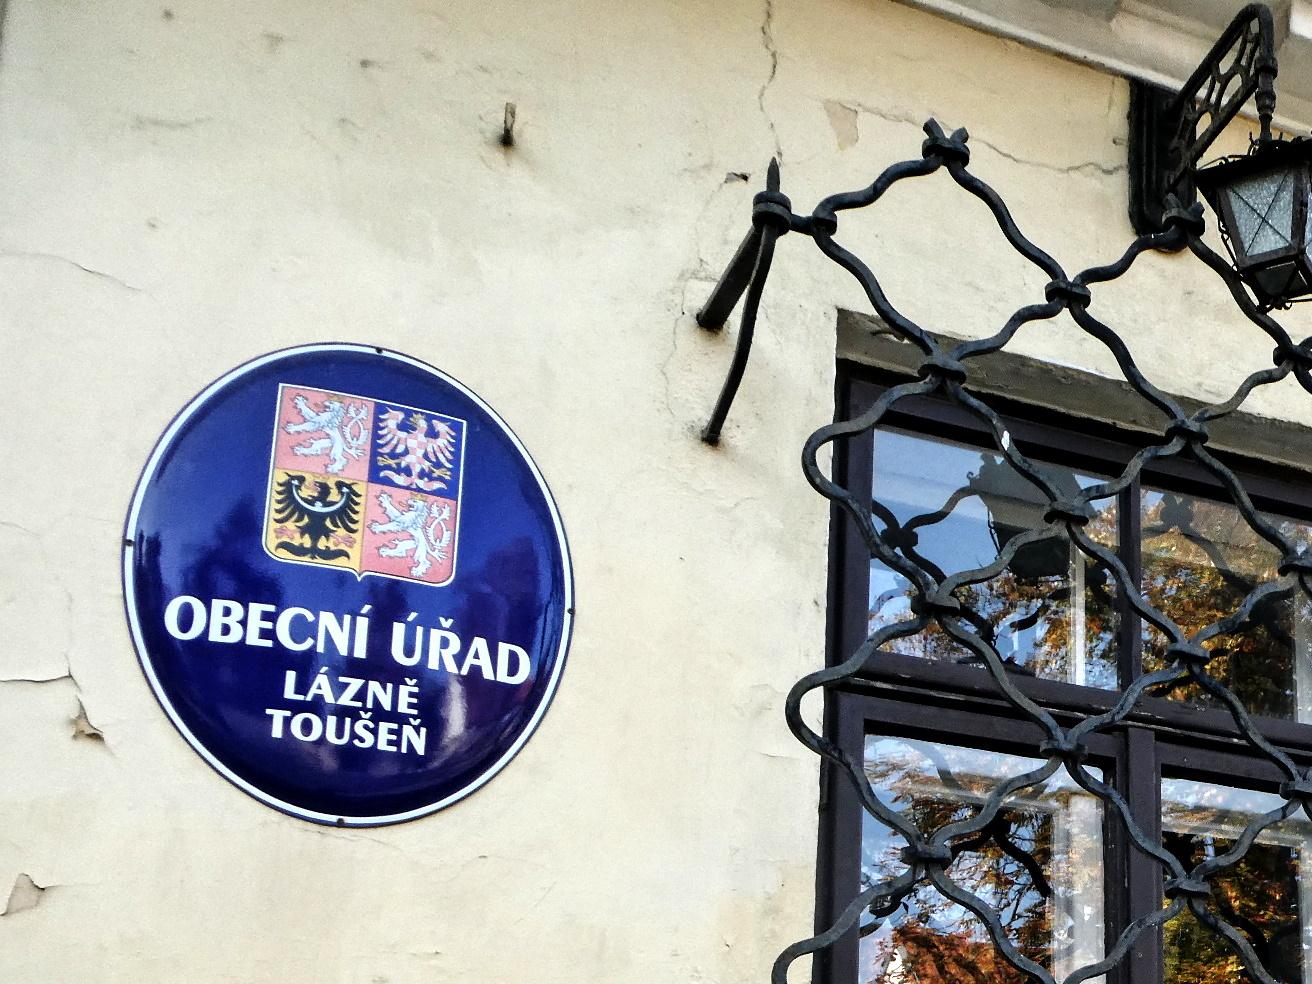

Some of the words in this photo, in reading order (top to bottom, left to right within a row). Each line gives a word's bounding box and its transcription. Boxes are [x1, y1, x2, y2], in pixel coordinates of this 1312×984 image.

[164, 595, 372, 659] OBECNÍ
[391, 611, 531, 685] ÚŘAD
[283, 666, 420, 715] LÁZNĚ
[265, 708, 427, 756] TOUŠEŇ
